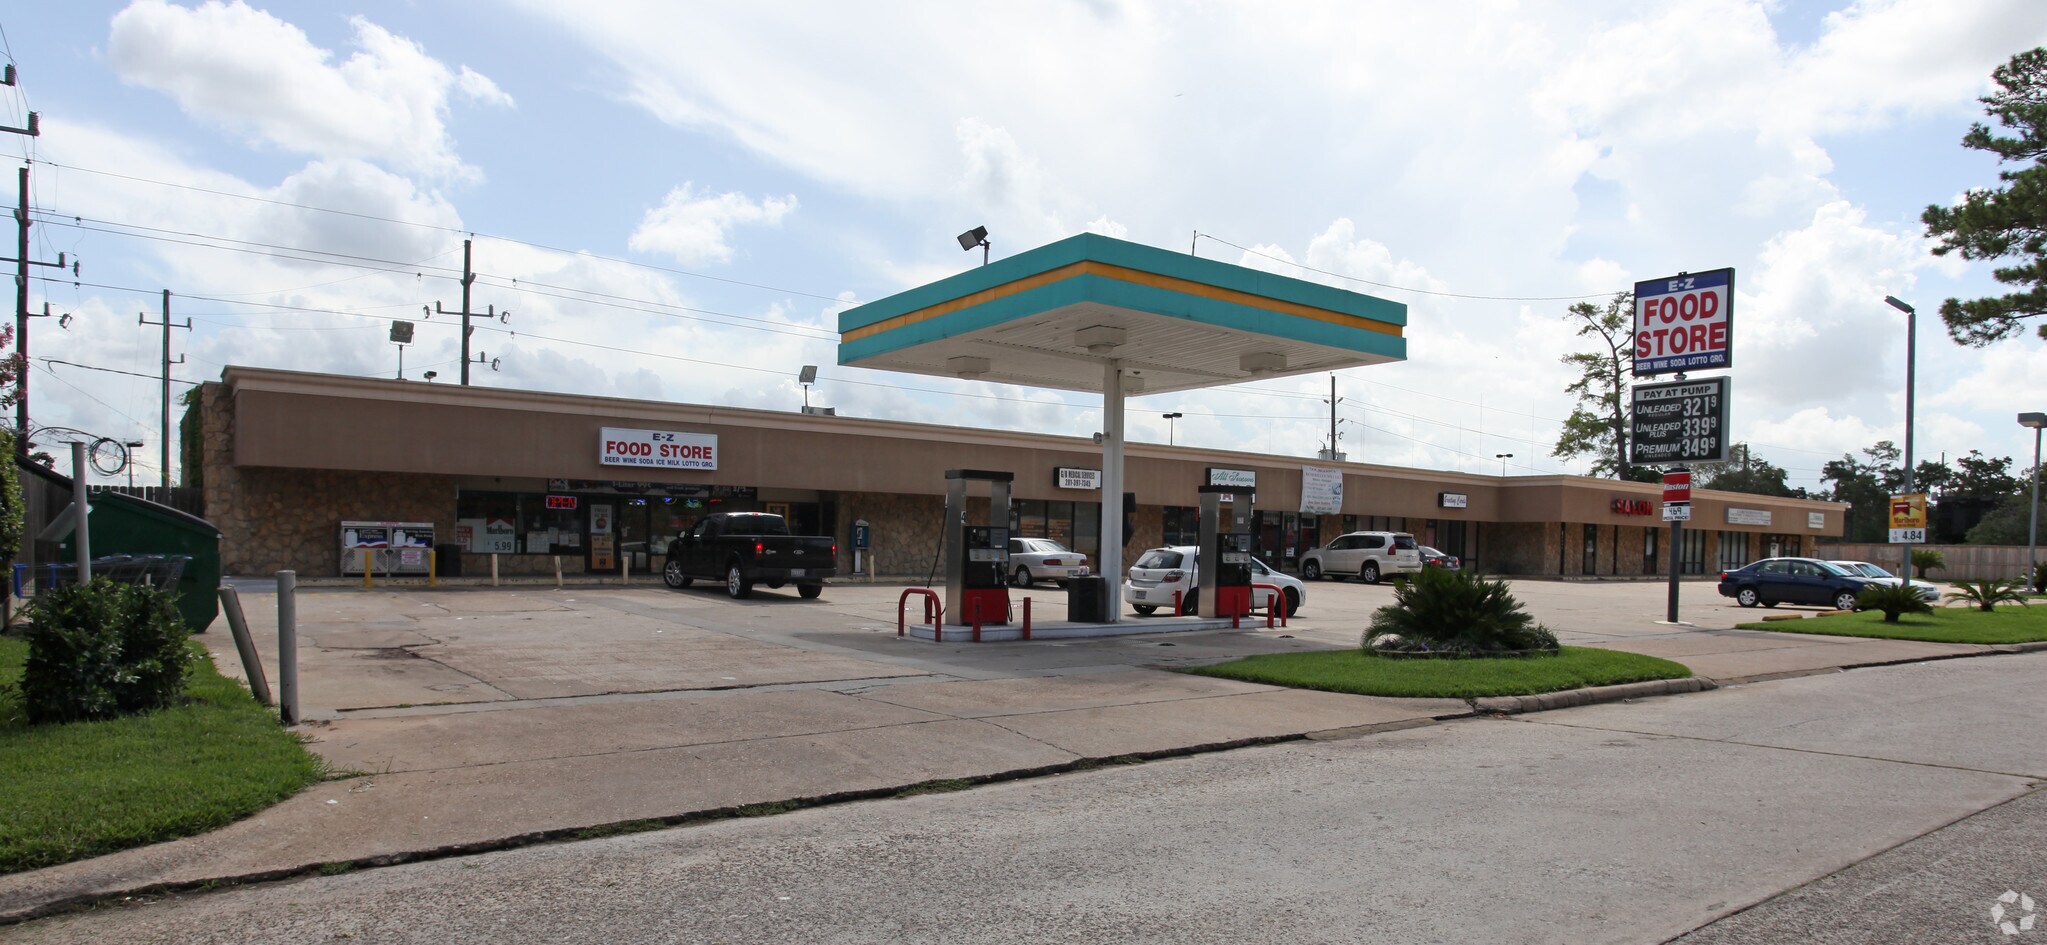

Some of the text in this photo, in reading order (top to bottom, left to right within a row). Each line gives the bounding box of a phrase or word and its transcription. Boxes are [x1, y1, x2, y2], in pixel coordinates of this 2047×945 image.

[1668, 278, 1695, 291] E-Z
[1644, 291, 1718, 326] FOOD
[1637, 321, 1726, 358] STORE
[1636, 355, 1724, 370] BEER WINE SODA LOTTO GRO.
[1644, 386, 1711, 399] PAY AT PUMP
[653, 433, 674, 441] E-Z
[606, 441, 712, 459] FOOD STORE
[1636, 443, 1680, 454] PREMIUM
[1212, 471, 1228, 480] All
[548, 497, 575, 508] OPEN
[1616, 498, 1653, 516] SALON
[487, 525, 513, 534] Marlboro
[1902, 531, 1922, 540] 4.84
